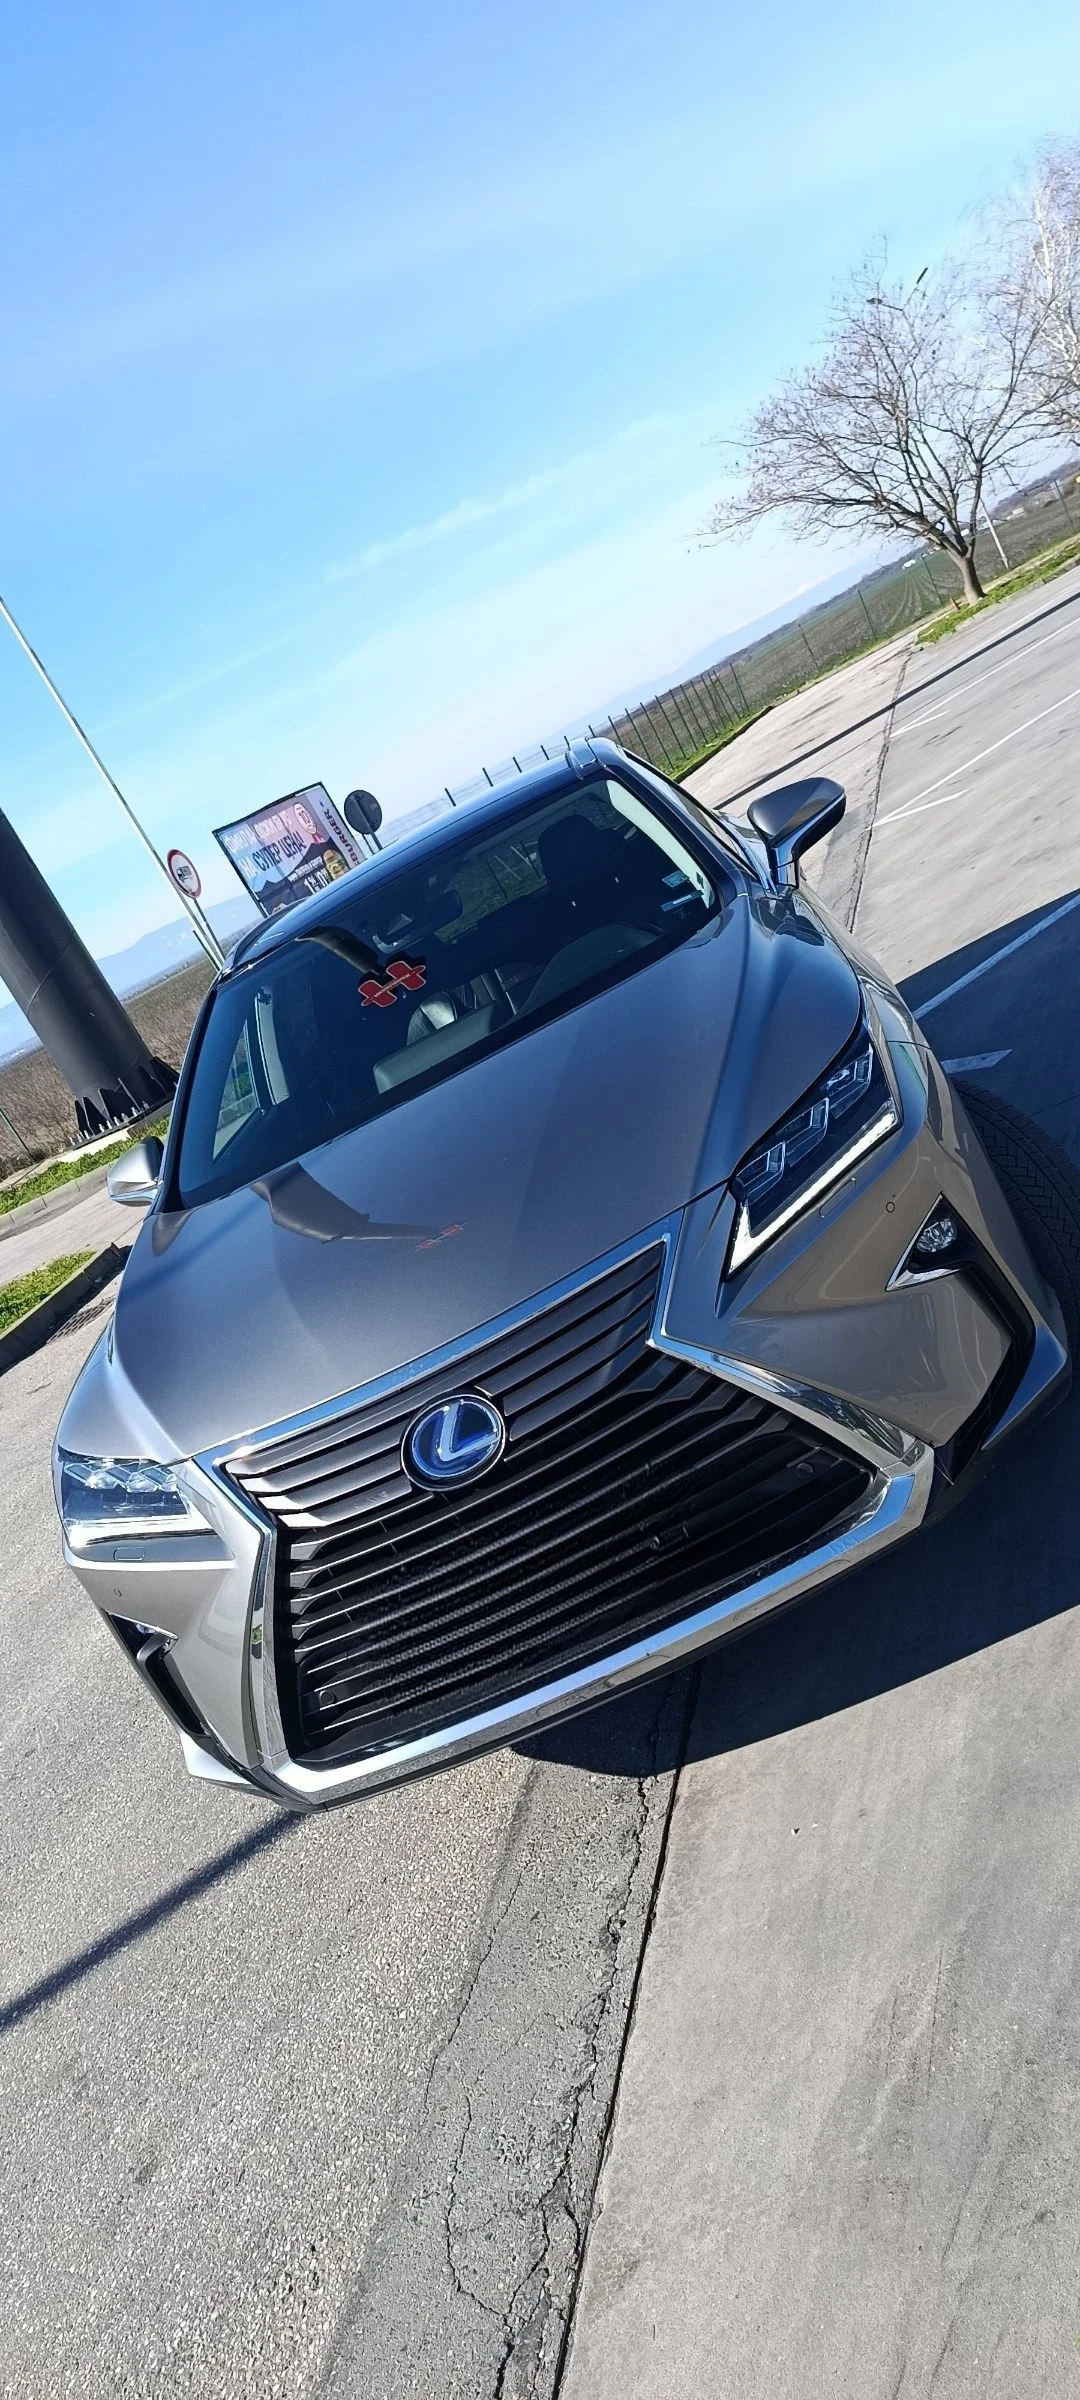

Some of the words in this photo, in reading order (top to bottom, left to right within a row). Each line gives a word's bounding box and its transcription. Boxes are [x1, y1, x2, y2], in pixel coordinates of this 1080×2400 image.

[237, 855, 260, 879] НА
[251, 842, 283, 872] СУПЕР
[277, 830, 308, 860] ЦЕНА!
